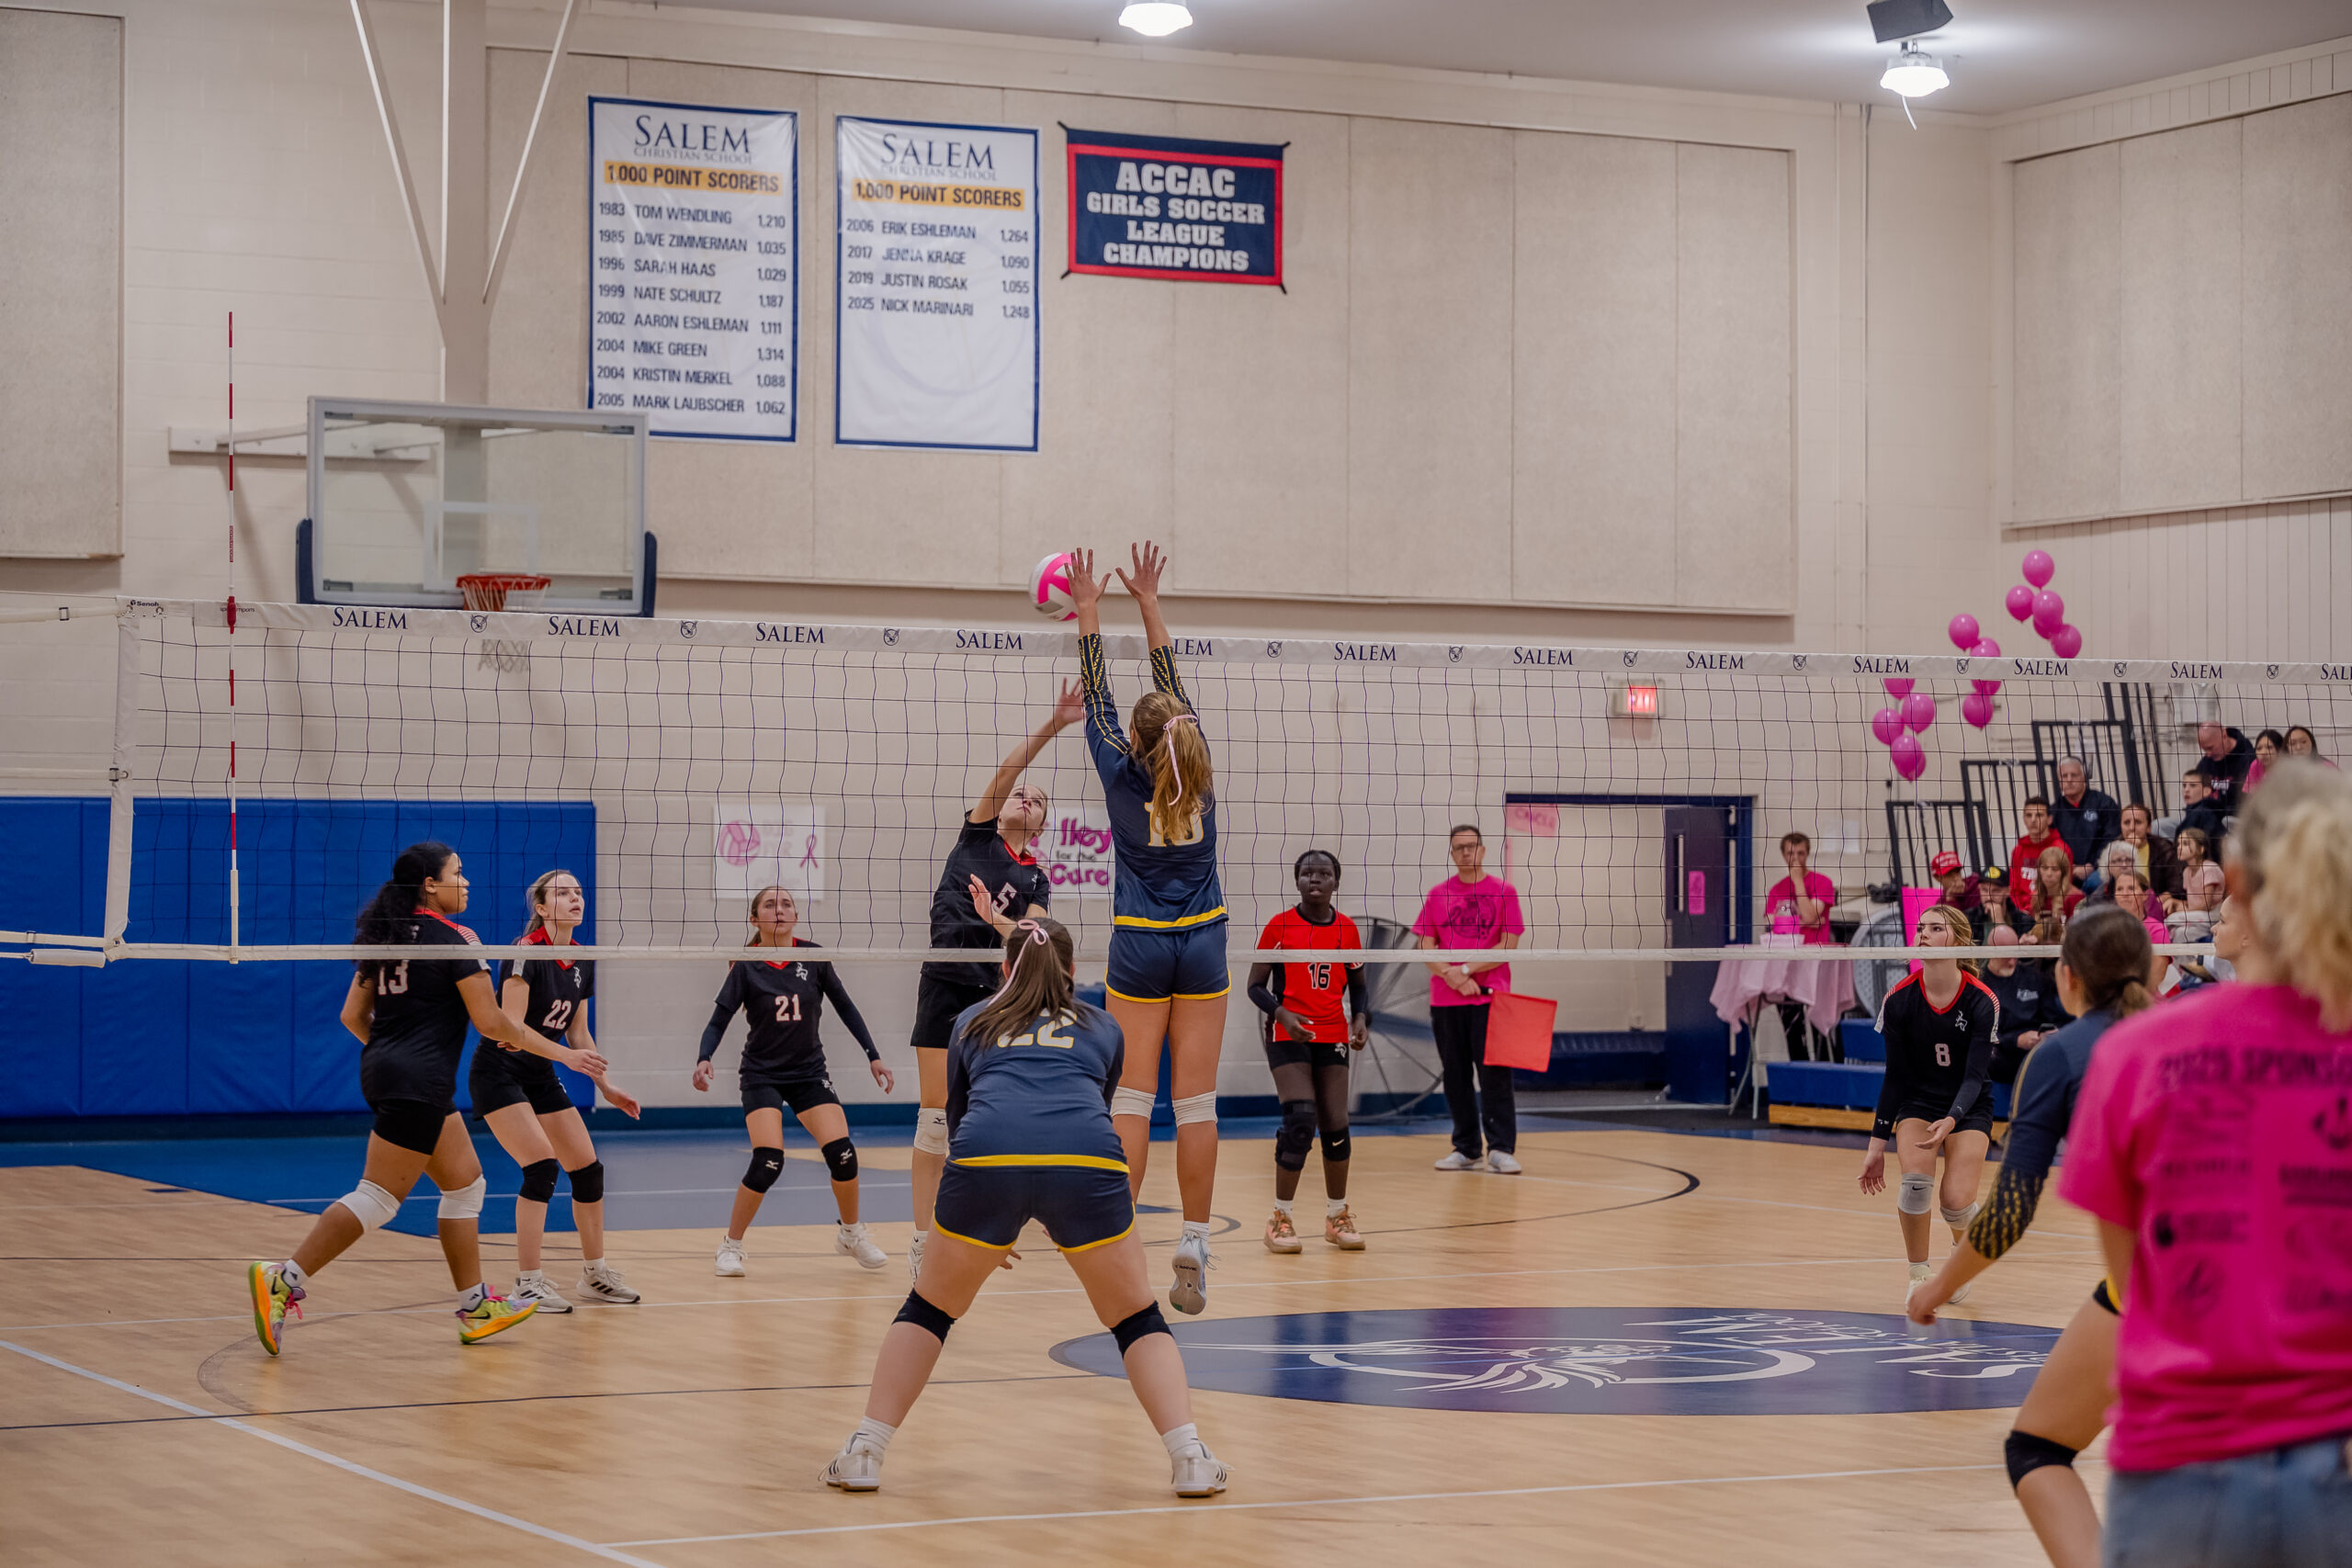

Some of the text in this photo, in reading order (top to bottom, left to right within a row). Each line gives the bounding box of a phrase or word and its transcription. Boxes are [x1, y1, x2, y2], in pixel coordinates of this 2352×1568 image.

[635, 115, 750, 153] SALEM
[634, 148, 752, 164] CHRISTIAN SCHOOL
[881, 133, 994, 170] SALEM
[654, 168, 702, 186] POINT
[708, 172, 778, 192] SCORERS
[882, 165, 997, 181] CHRISTIAN SCHOOL
[1115, 161, 1236, 198] ACCAC
[855, 183, 1022, 207] 1,000 POINT SCORERS
[599, 202, 625, 216] 1983
[635, 205, 662, 219] TOM
[667, 208, 731, 224] WENDLING
[1086, 191, 1265, 225] GIRLS SOCCER
[846, 219, 875, 232] 2006
[882, 220, 908, 235] ERIK
[910, 222, 977, 239] ESHLEMAN
[1126, 220, 1225, 247] LEAGUE
[599, 230, 625, 243] 1985
[635, 231, 664, 247] DAVE
[669, 234, 747, 252] ZIMMERMAN
[847, 245, 873, 259] 2017
[882, 247, 923, 262] JENNA
[927, 250, 967, 265] KRAGE
[1103, 242, 1250, 272] CHAMPIONS
[599, 257, 625, 270] 1996
[634, 259, 677, 275] SARAH
[682, 262, 716, 276] HAAS
[848, 271, 874, 285] 2019
[881, 273, 924, 288] JUSTIN
[928, 276, 968, 290] ROSAK
[599, 285, 625, 298] 1999
[634, 287, 665, 301] NATE
[670, 288, 721, 304] SCHULTZ
[847, 296, 875, 310] 2025
[881, 298, 909, 312] NICK
[912, 300, 974, 316] MARINARI
[597, 312, 626, 325] 2002
[634, 314, 678, 329] AARON
[684, 316, 749, 332] ESHLEMAN
[597, 339, 625, 352] 2004
[633, 341, 663, 355] MIKE
[668, 343, 707, 357] GREEN
[597, 366, 625, 379] 2004
[633, 367, 681, 383] KRISTIN
[685, 370, 732, 386] MERKEL
[597, 393, 625, 407] 2005
[633, 395, 671, 410] MARK
[674, 397, 744, 412] LAUBSCHER
[333, 607, 408, 630] SALEM
[548, 615, 621, 637] SALEM
[755, 622, 825, 644] SALEM
[956, 629, 1023, 651] SALEM
[1174, 638, 1214, 656] LEM
[1334, 642, 1396, 662] SALEM
[1513, 647, 1573, 666] SALEM
[1686, 650, 1744, 671] SALEM
[1852, 655, 1910, 674] SALEM
[2014, 659, 2069, 677] SALEM
[2170, 661, 2223, 680] SALEM
[1051, 863, 1110, 886] Cure
[992, 882, 1017, 915] 5
[378, 958, 409, 996] 13
[1307, 963, 1331, 990] 16
[542, 998, 571, 1030] 22
[775, 994, 801, 1021] 21
[1935, 1043, 1951, 1066] 8
